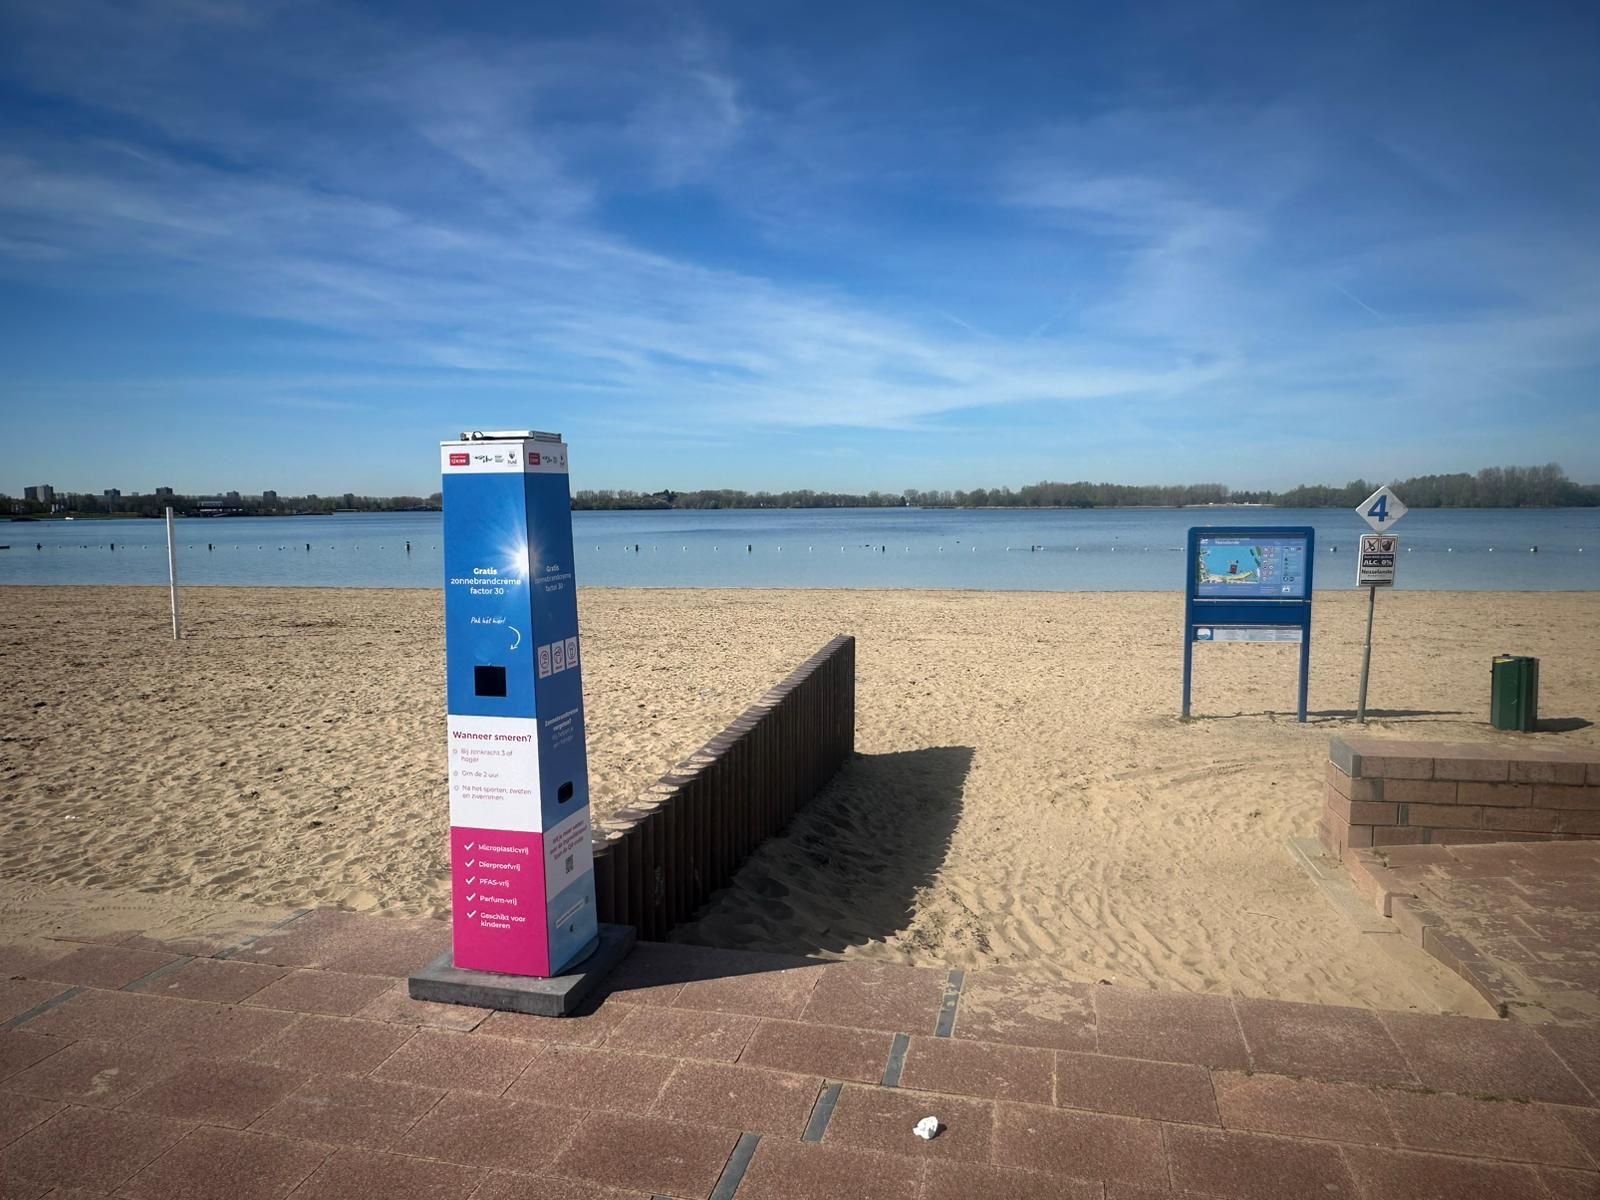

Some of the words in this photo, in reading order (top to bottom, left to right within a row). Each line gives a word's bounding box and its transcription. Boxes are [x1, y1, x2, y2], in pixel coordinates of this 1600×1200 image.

[1368, 495, 1388, 521] 4
[470, 587, 493, 595] factor
[452, 731, 493, 740] Wanneer
[494, 734, 532, 742] smeren?
[478, 844, 529, 855] Microplasticvrij
[479, 861, 521, 871] Dierproefvrij
[480, 879, 510, 888] PFAS-vrij
[480, 895, 517, 906] Parfum-vrij
[480, 912, 509, 921] Geschikt
[480, 920, 511, 929] kinderen
